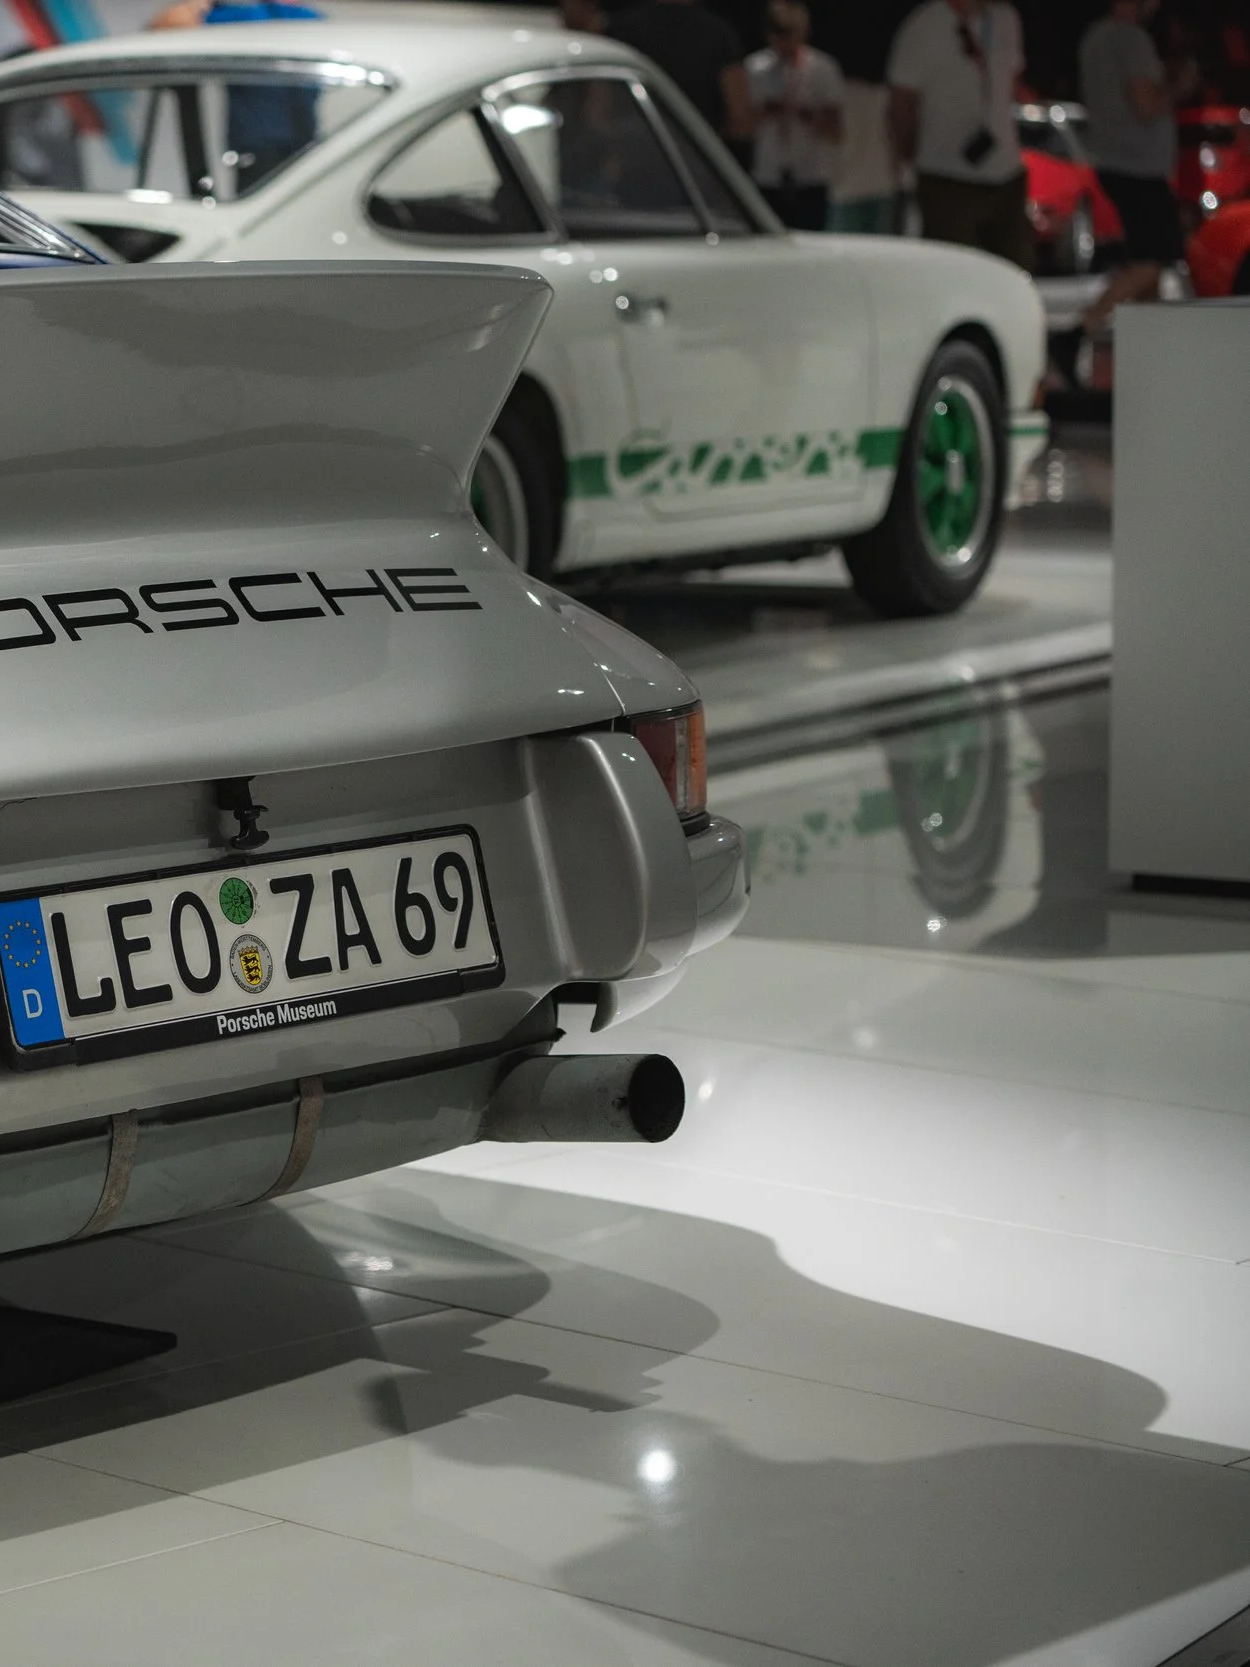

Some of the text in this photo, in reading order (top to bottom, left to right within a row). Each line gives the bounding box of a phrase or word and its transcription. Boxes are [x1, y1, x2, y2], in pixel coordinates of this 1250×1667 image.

[52, 891, 222, 1018] LEO
[270, 868, 381, 979] ZA
[395, 852, 473, 956] 69
[22, 988, 43, 1018] D
[216, 1000, 337, 1035] Porsche Museum
